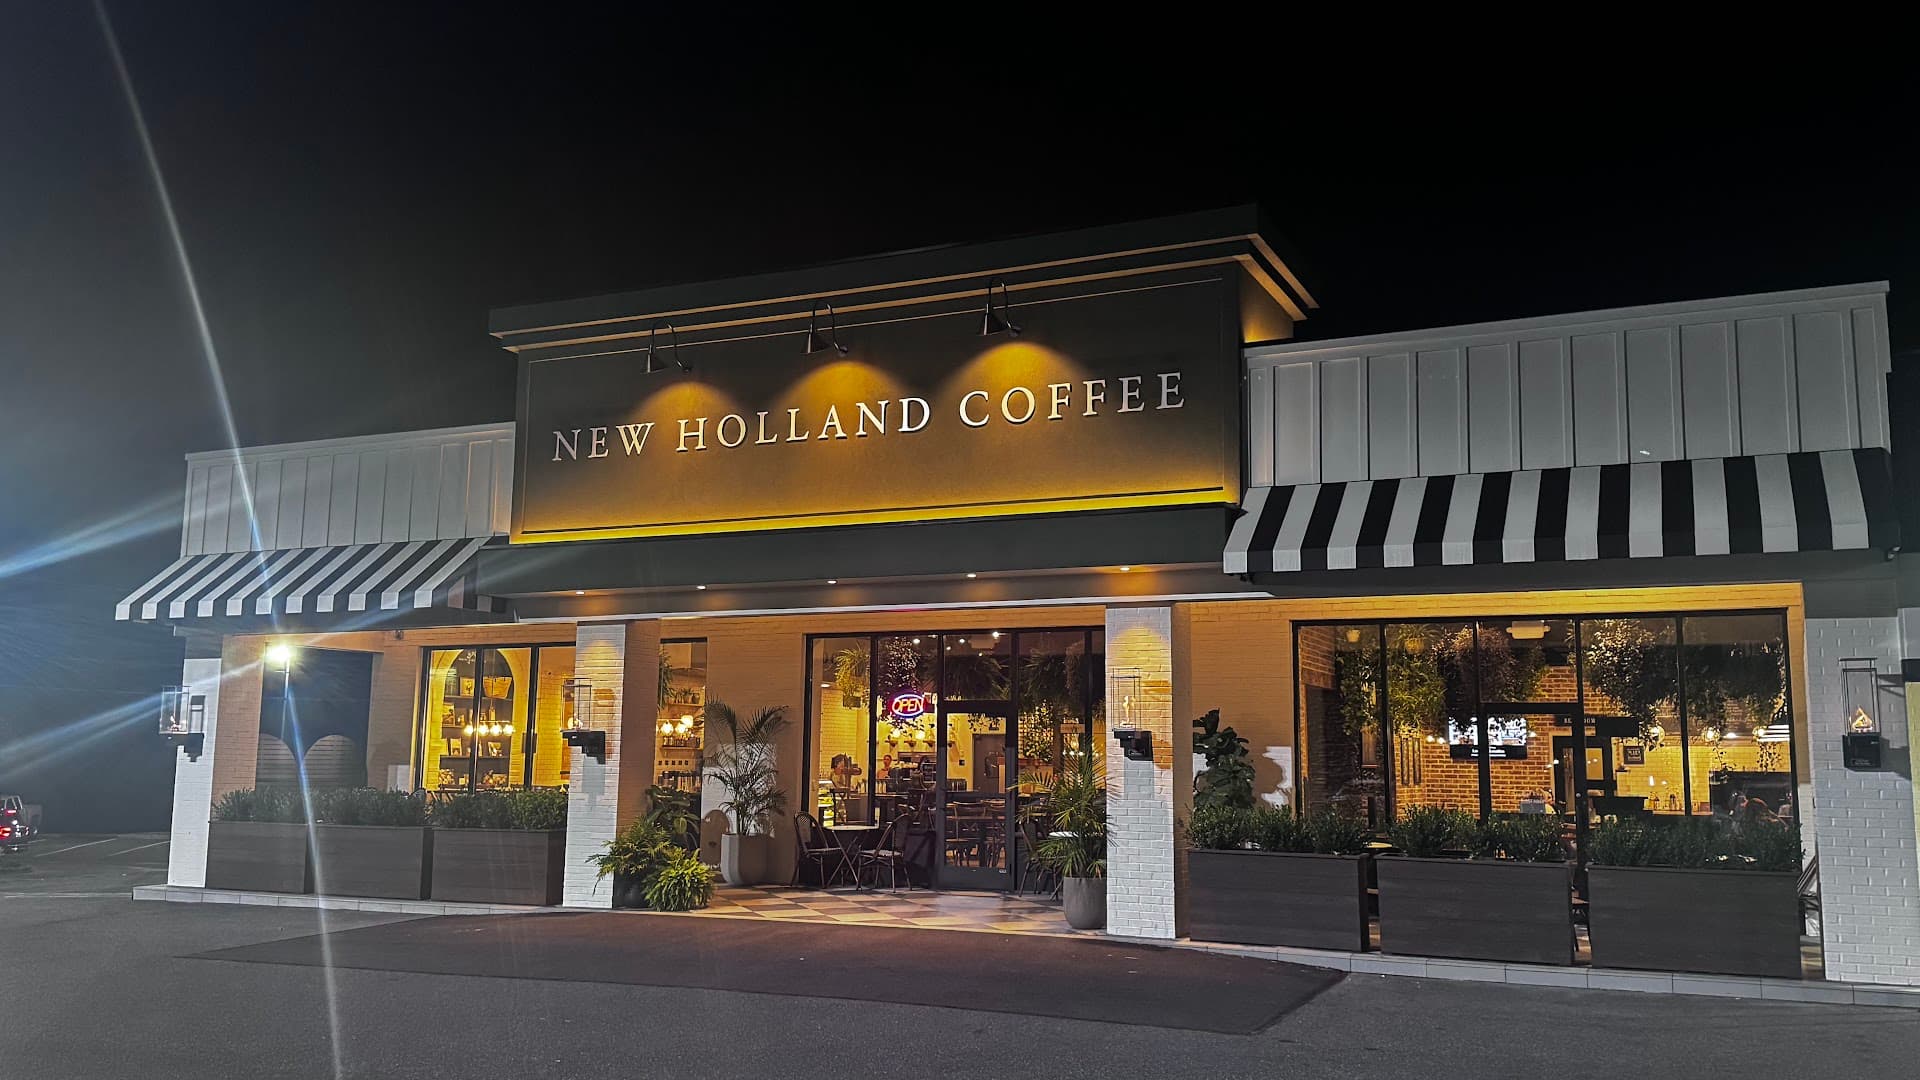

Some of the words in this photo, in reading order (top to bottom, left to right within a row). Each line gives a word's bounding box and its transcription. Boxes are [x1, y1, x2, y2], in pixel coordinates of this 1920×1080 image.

[551, 422, 655, 462] NEW
[676, 396, 932, 452] HOLLAND
[958, 371, 1186, 428] COFFEE
[893, 697, 923, 712] OPEN
